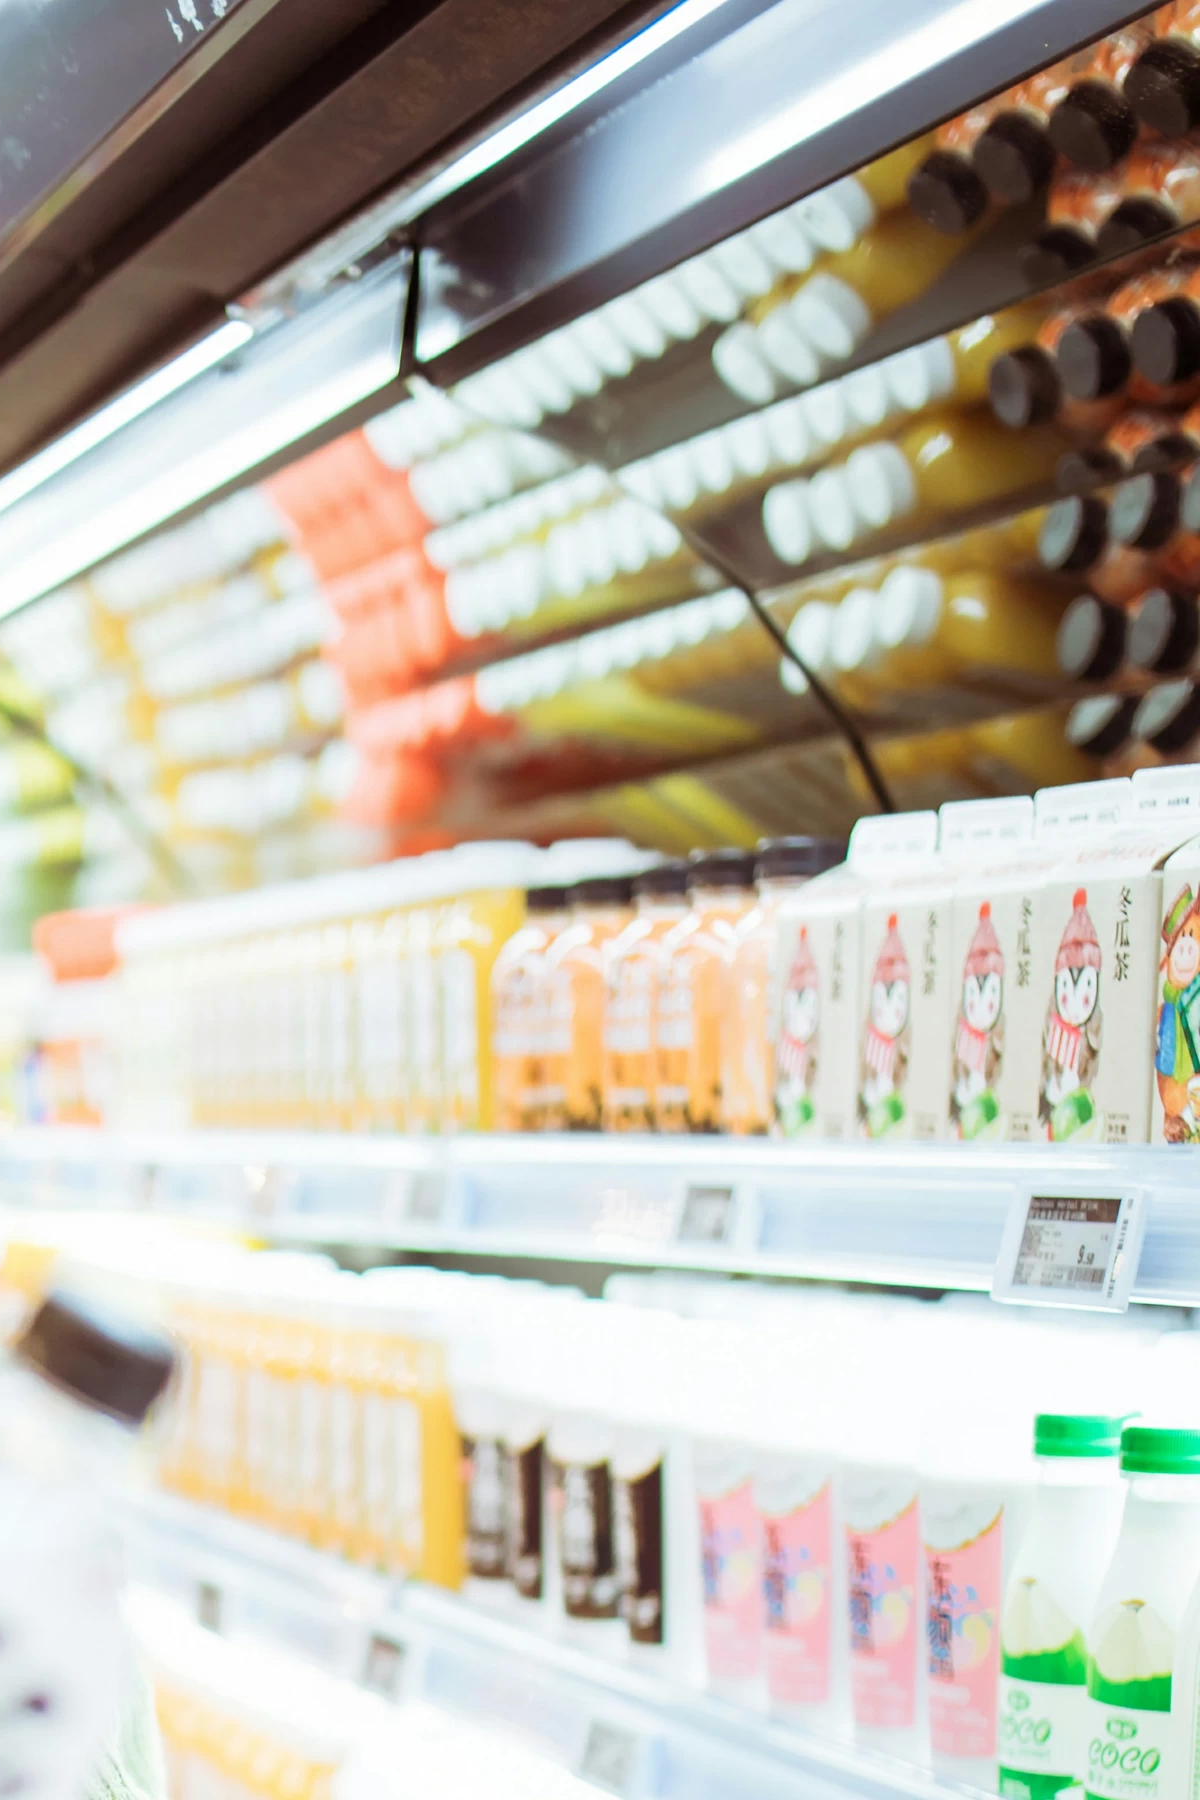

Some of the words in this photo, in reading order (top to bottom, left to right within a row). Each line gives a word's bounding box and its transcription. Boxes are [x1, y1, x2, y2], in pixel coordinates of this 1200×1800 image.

[1113, 885, 1132, 981] 冬瓜茶
[1088, 1737, 1162, 1776] COCO
